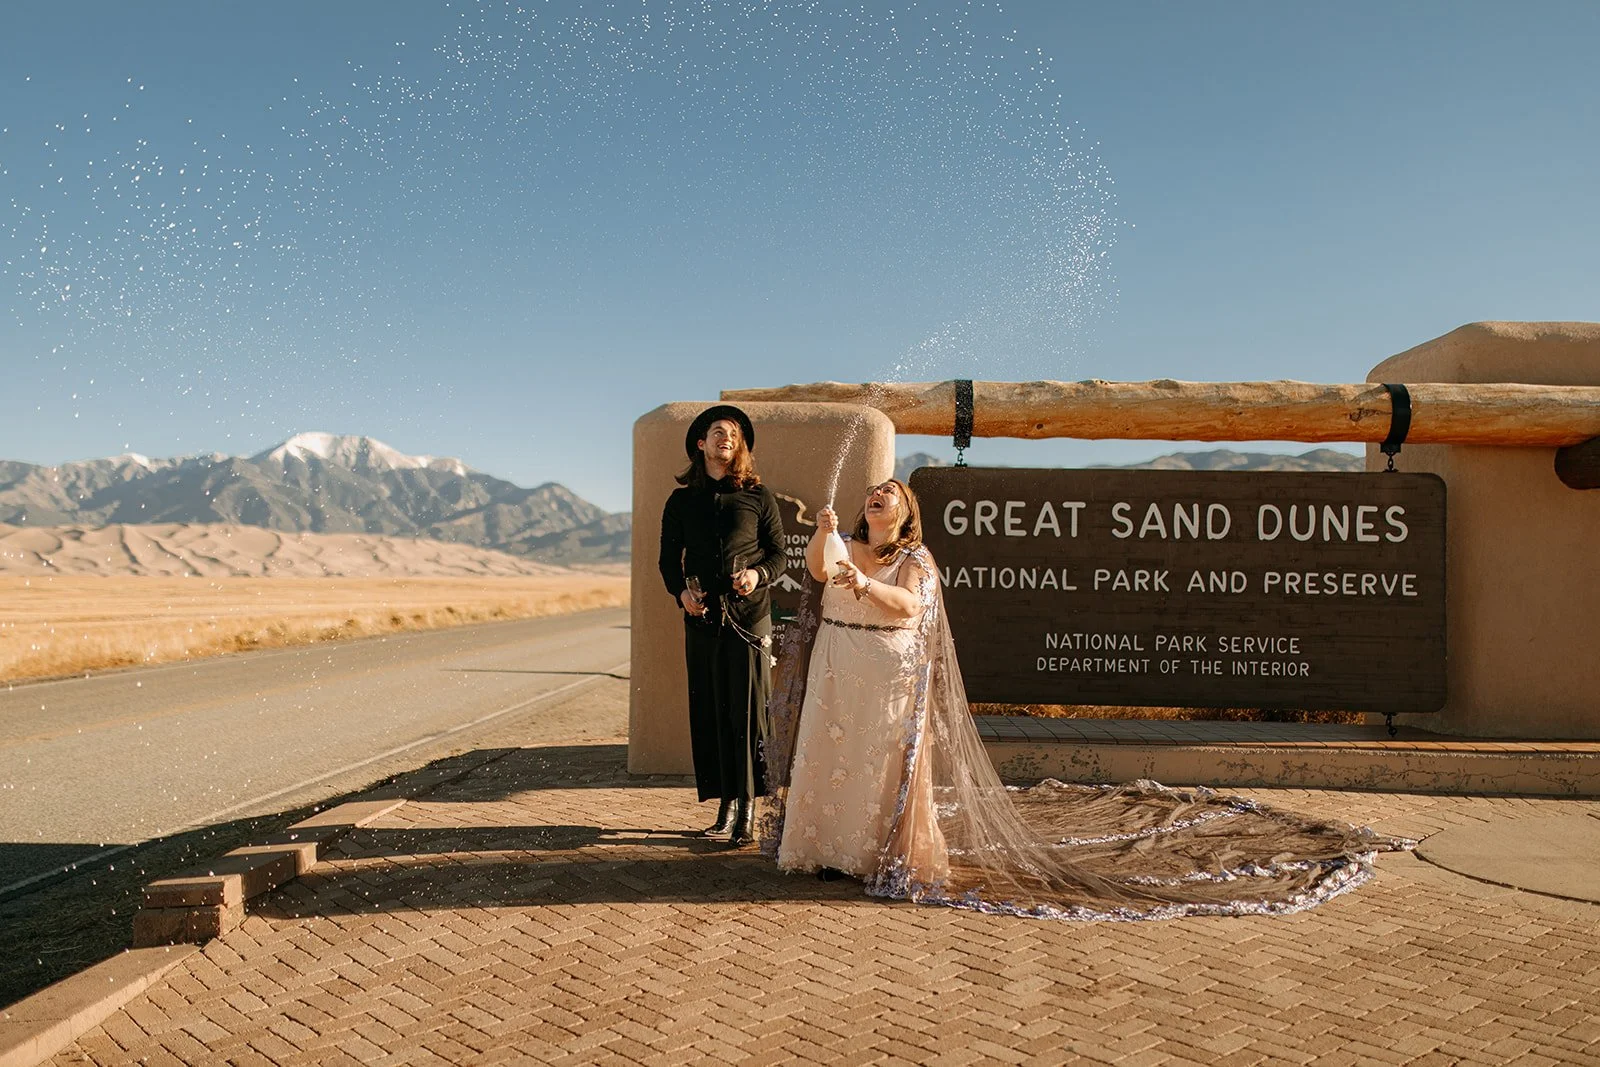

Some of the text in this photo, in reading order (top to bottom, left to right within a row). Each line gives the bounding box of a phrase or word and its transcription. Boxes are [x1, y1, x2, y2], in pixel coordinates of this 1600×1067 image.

[943, 499, 1409, 543] GREAT SAND DUNES
[937, 566, 1418, 596] NATIONAL PARK AND PRESERVE
[1045, 633, 1301, 654] NATIONAL PARK SERVICE
[1036, 657, 1310, 677] DEPARTMENT OF THE INTERIOR
